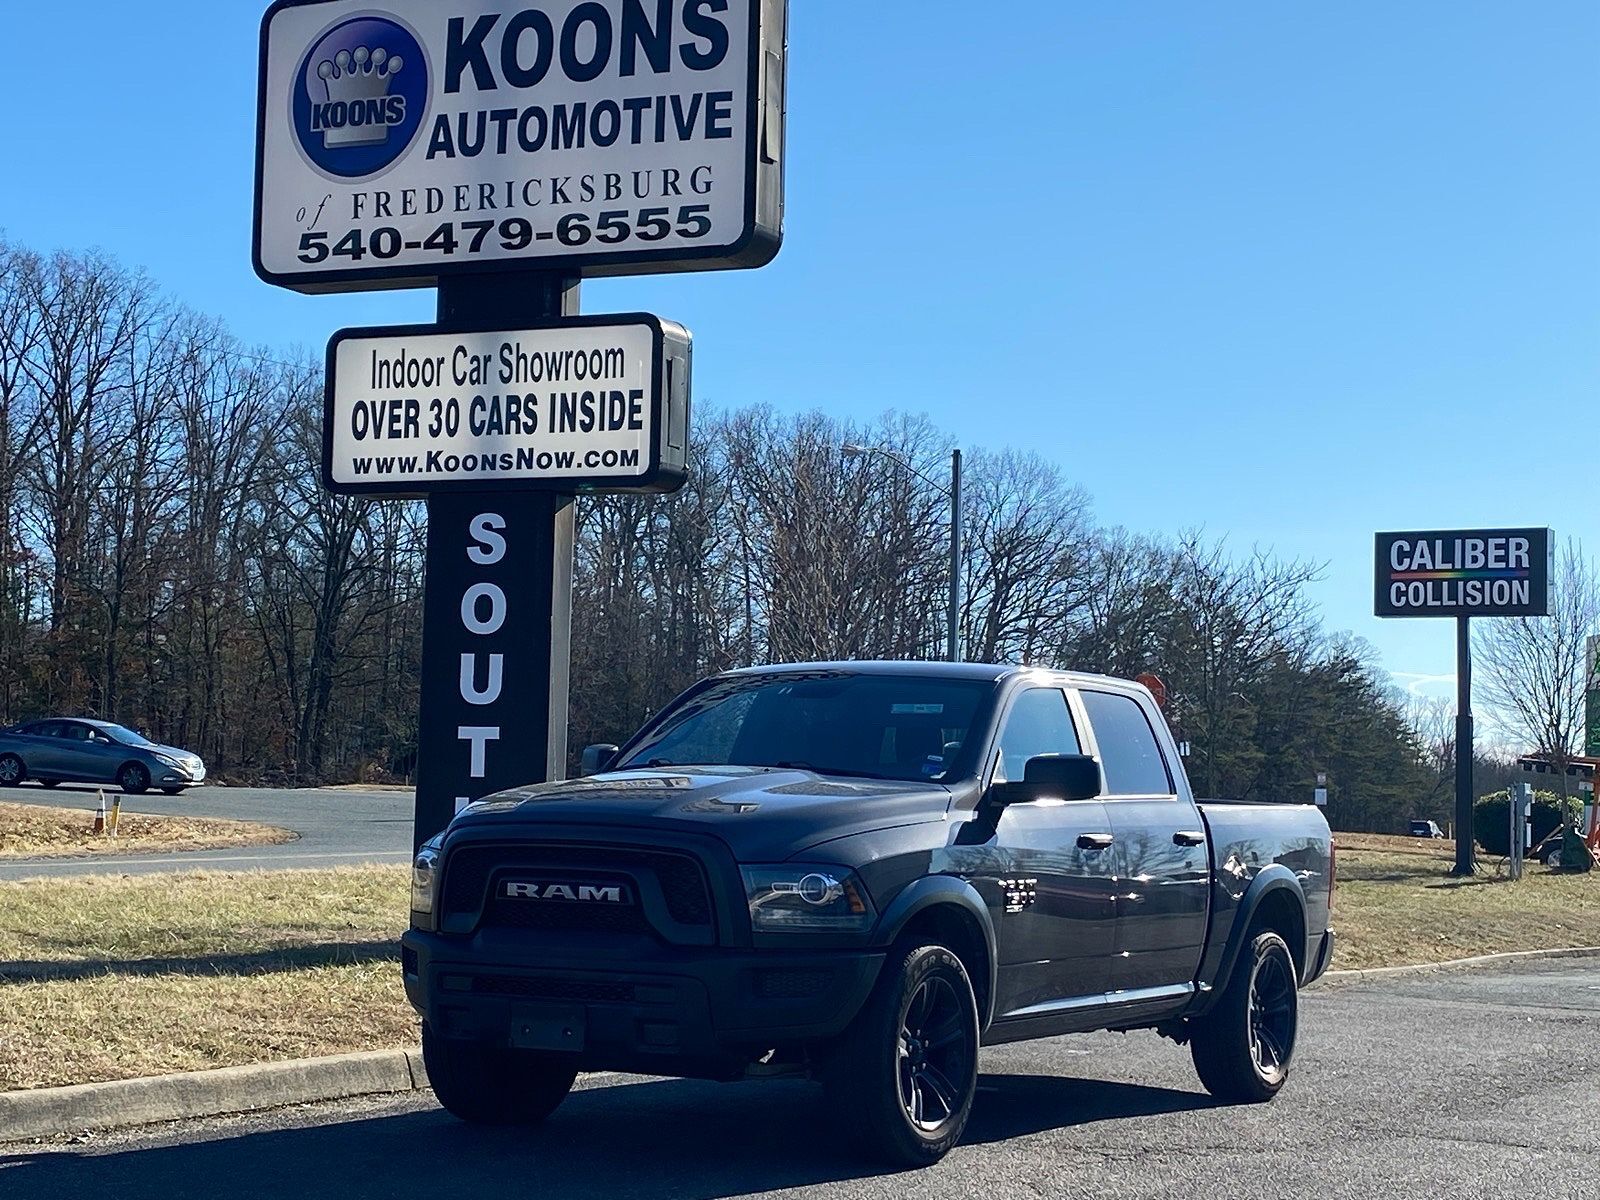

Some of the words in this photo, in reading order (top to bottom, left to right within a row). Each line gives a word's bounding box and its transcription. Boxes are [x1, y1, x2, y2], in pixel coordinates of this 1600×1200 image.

[444, 0, 729, 93] KOONS
[312, 96, 405, 129] KOONS
[426, 91, 733, 160] AUTOMOTIVE
[296, 194, 331, 230] of
[352, 166, 714, 220] FREDERICKSBURG
[297, 205, 711, 264] 540-479-6555
[371, 348, 445, 389] Indoor
[452, 345, 492, 386] Car
[499, 343, 625, 384] Showroom
[352, 399, 420, 441] OVER
[429, 397, 460, 438] 30
[469, 393, 538, 437] CARS
[549, 389, 643, 433] INSIDE
[1390, 537, 1530, 571] CALIBER
[1390, 580, 1530, 607] COLLISION
[454, 512, 507, 816] SOUT
[506, 882, 620, 902] RAM
